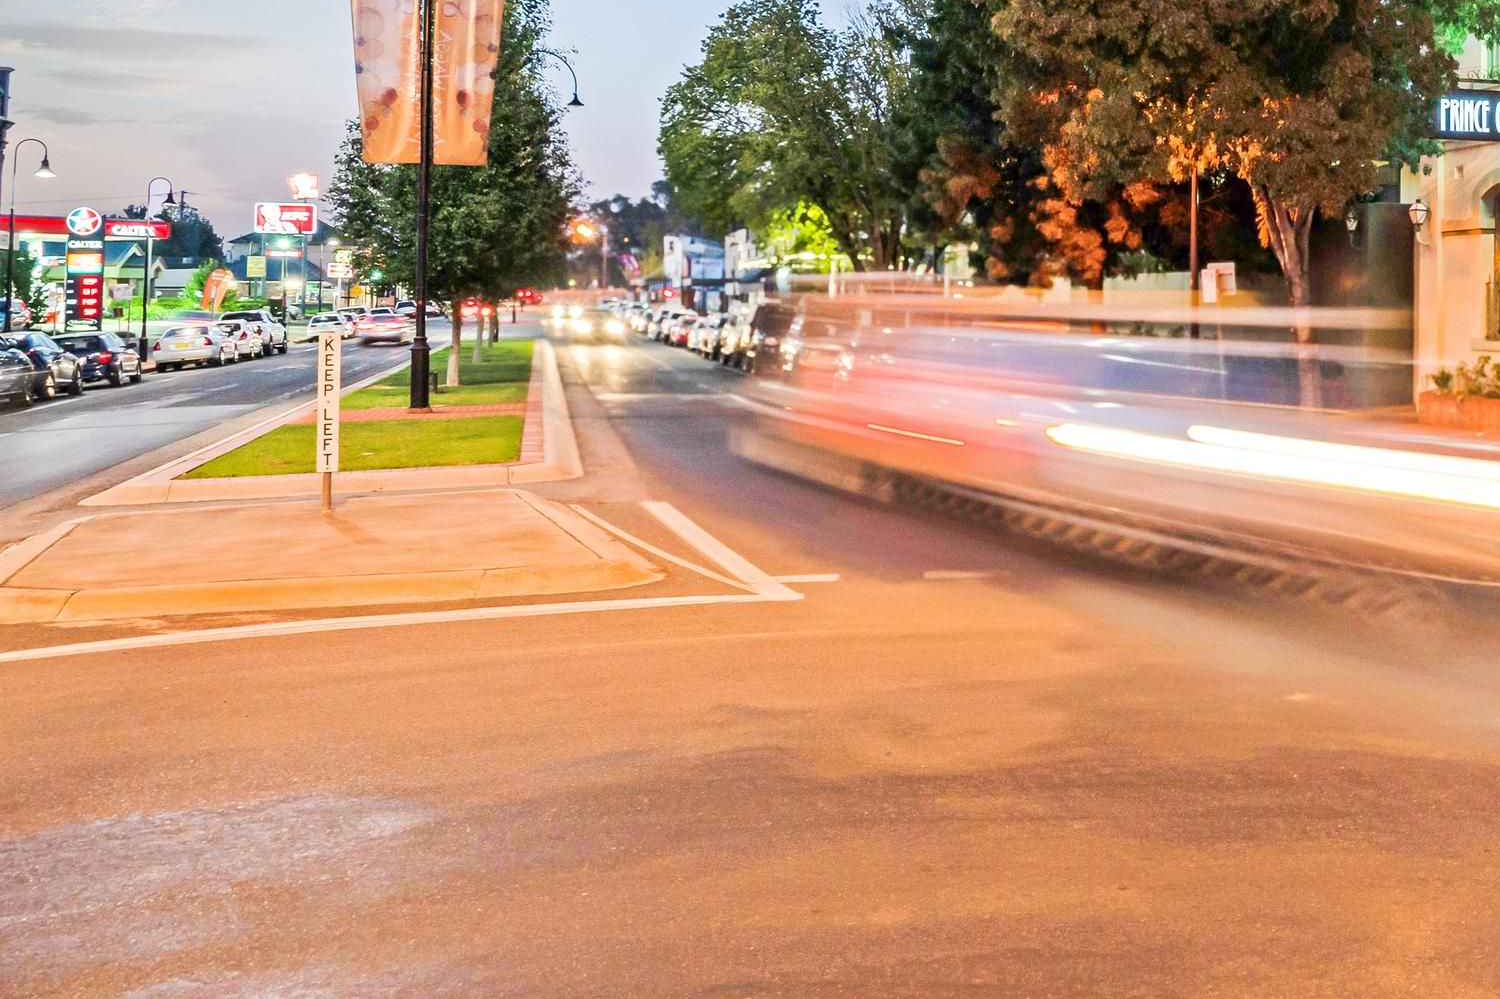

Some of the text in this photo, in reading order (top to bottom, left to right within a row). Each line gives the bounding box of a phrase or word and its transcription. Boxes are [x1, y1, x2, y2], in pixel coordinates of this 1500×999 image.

[1440, 98, 1490, 133] PRINCE
[323, 338, 334, 466] KEEP LEFT
